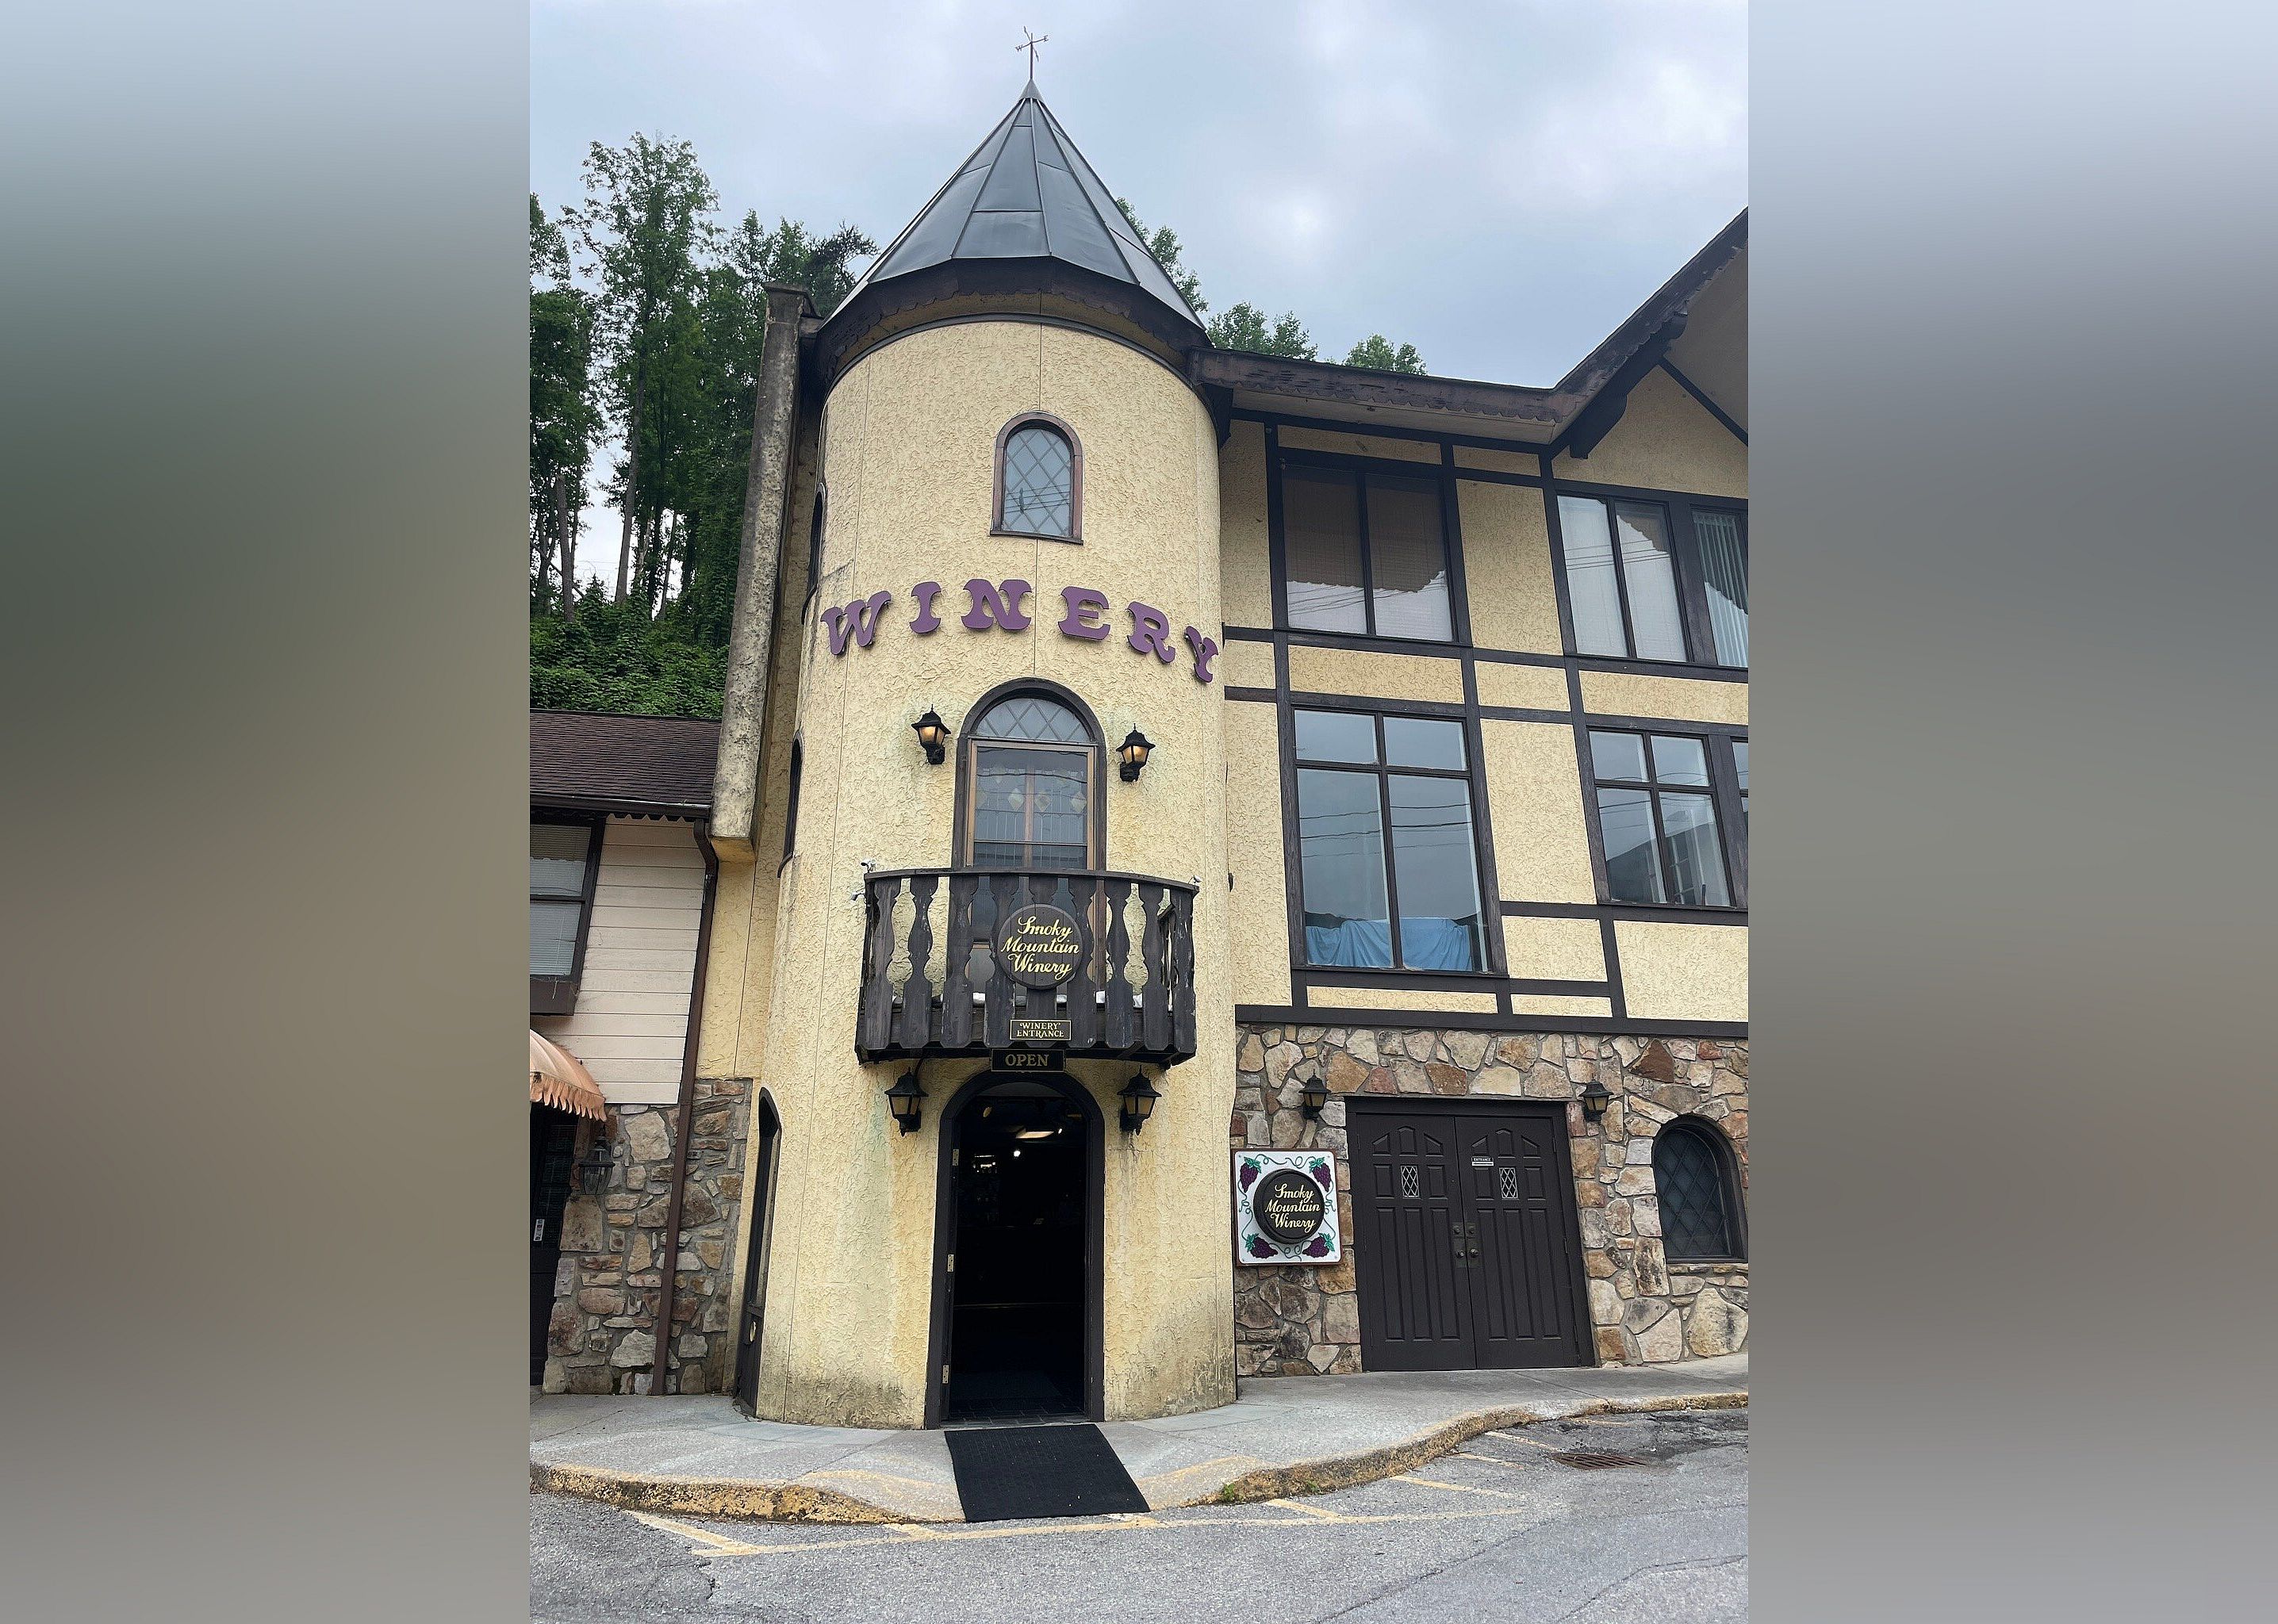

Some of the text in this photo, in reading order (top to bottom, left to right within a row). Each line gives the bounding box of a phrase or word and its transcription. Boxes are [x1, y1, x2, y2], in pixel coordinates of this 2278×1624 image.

[820, 579, 1220, 684] WINERY
[1018, 916, 1072, 941] Smoky
[1000, 936, 1080, 954] Mountain
[1007, 953, 1072, 980] Winery
[1005, 1054, 1049, 1067] OPEN
[1275, 1183, 1314, 1203] Smoky
[1264, 1199, 1321, 1212] Mountain
[1270, 1212, 1316, 1233] Winery
